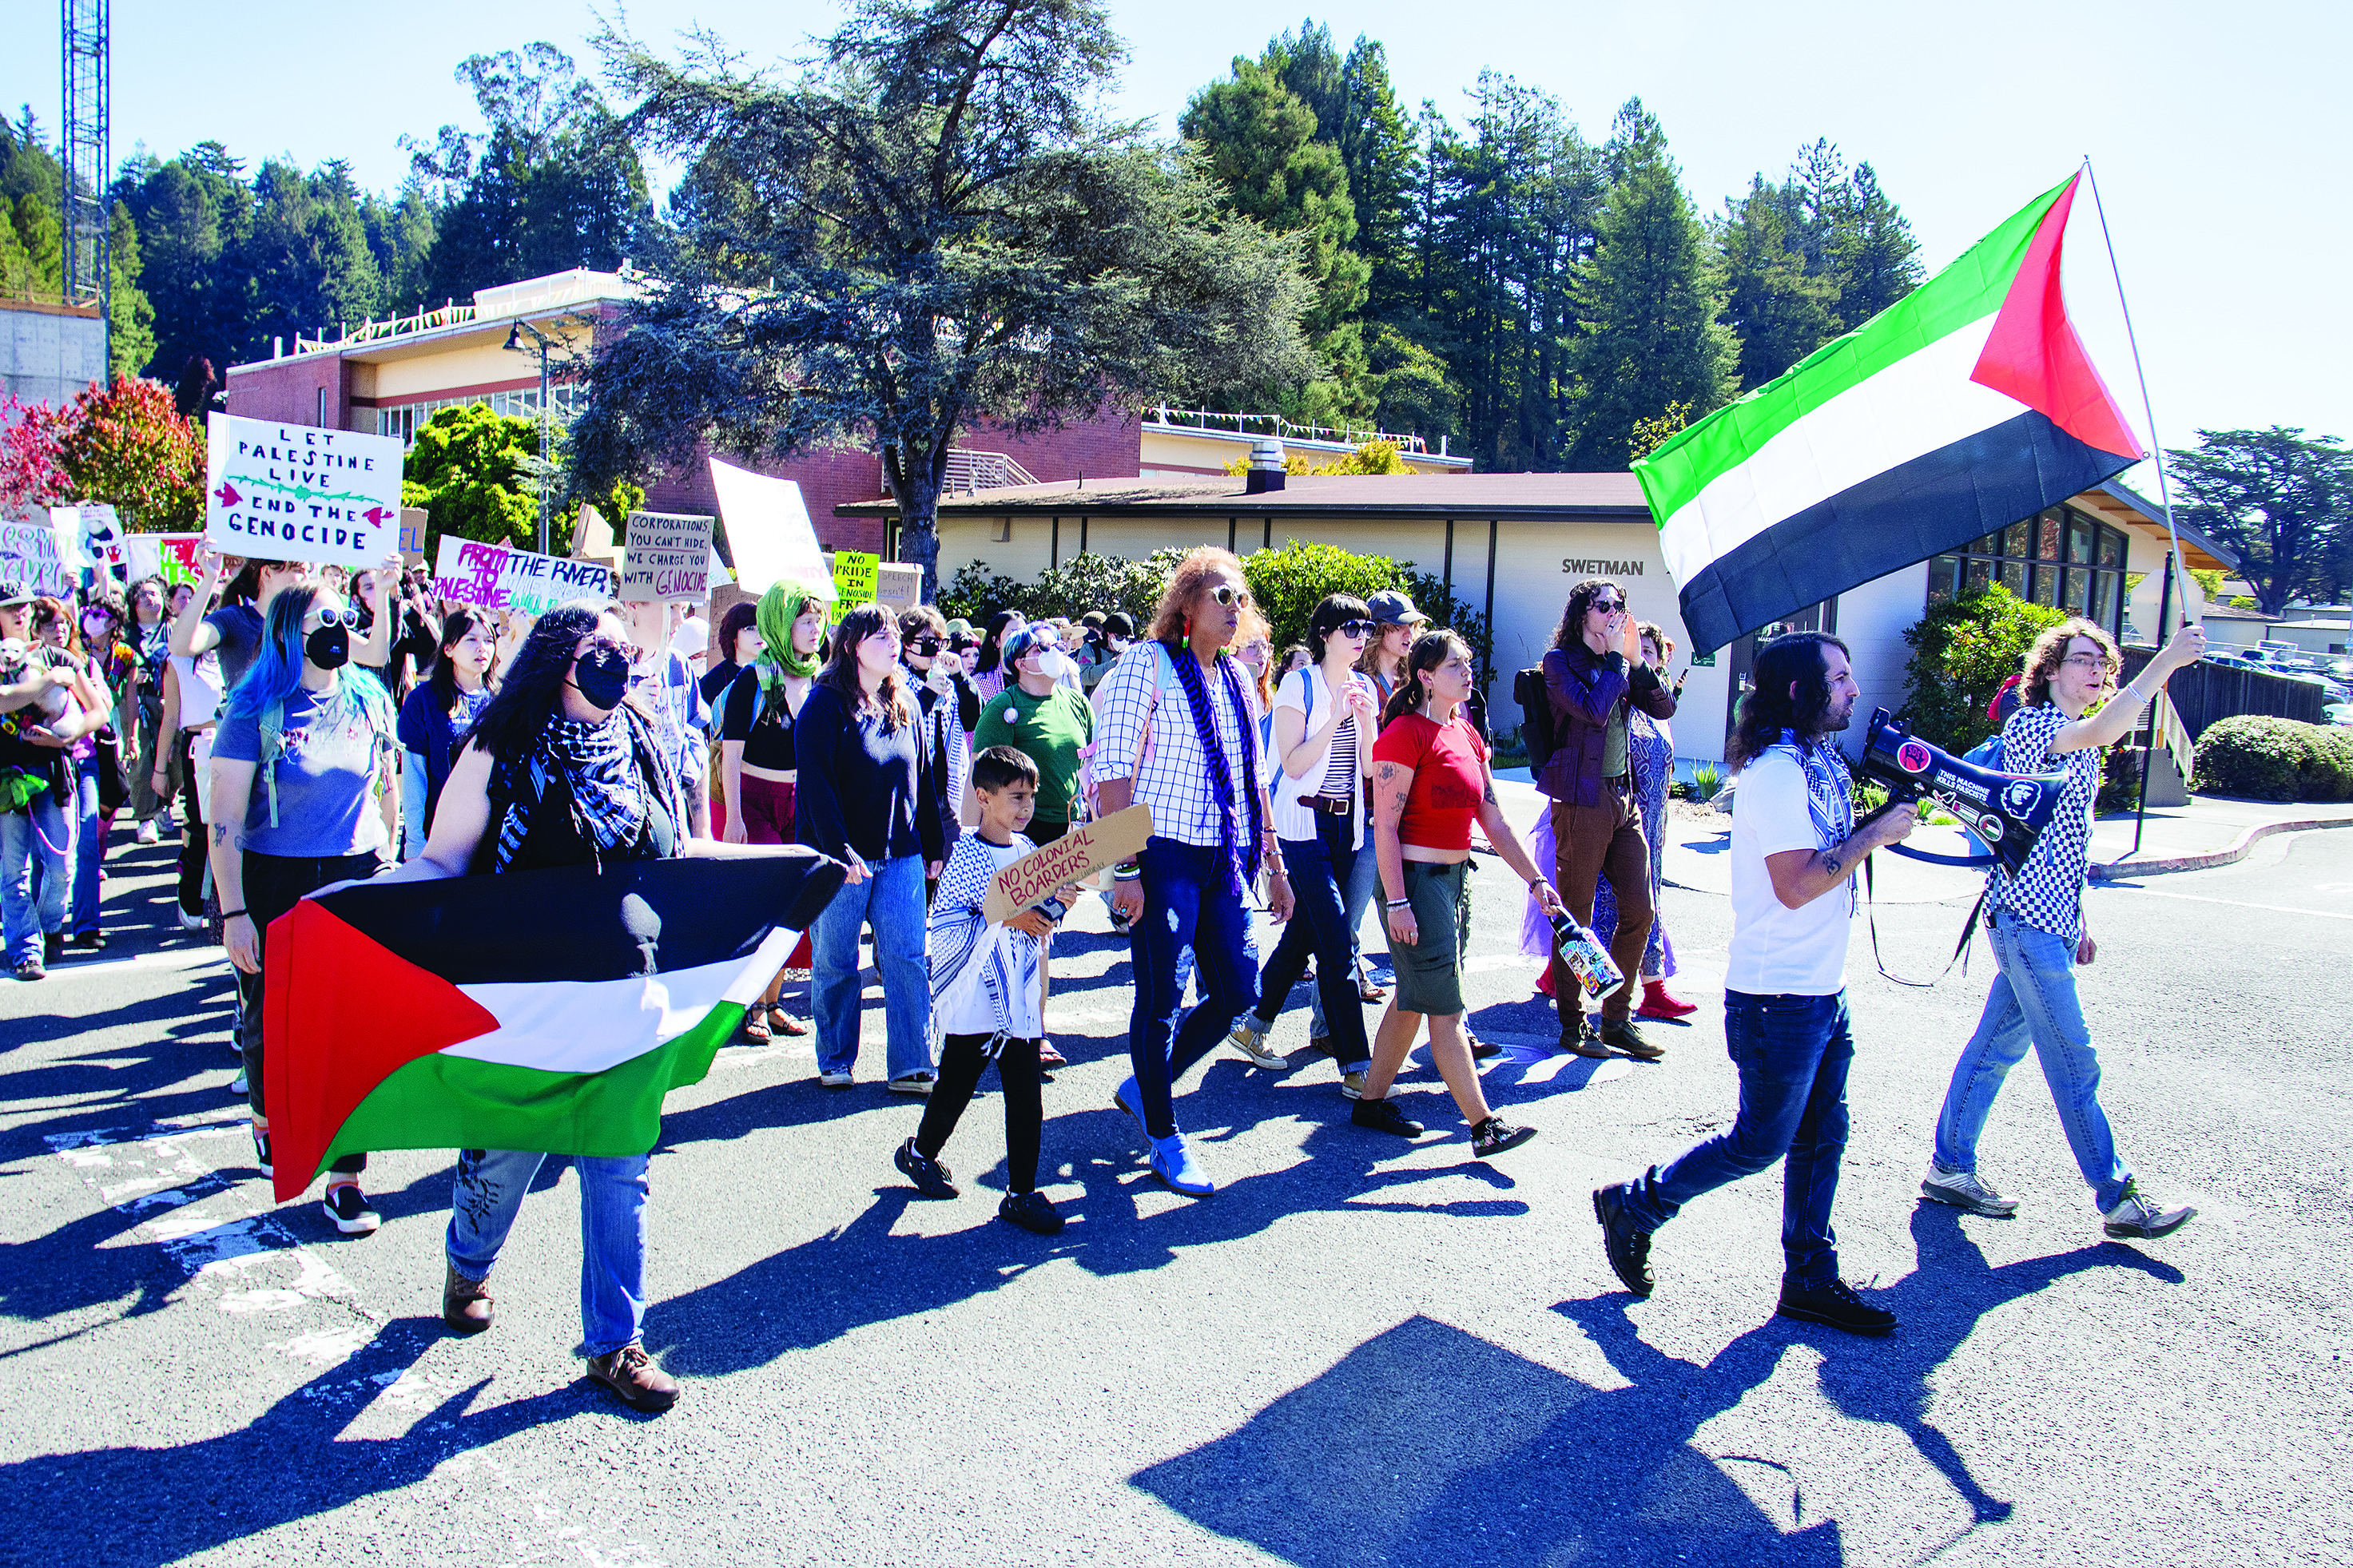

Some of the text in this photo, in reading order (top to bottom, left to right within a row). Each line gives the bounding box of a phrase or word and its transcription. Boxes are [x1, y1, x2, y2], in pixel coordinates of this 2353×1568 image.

[280, 429, 334, 445] LET
[239, 441, 374, 470] PALESTINE
[269, 468, 329, 487] LIVE
[252, 497, 356, 522] END THE
[229, 513, 367, 550] GENOCIDE
[632, 516, 710, 534] CORPORATIONS,
[630, 532, 707, 550] YOU CAN'T HIDE.
[458, 543, 509, 574] FROM
[508, 554, 550, 576] THE
[627, 553, 705, 566] WE CHARGE YOU
[847, 555, 864, 564] NO
[1561, 558, 1644, 576] SWETMAN
[469, 568, 499, 588] TO
[624, 571, 654, 584] WITH
[656, 569, 708, 595] GENOCIDE
[836, 565, 872, 578] PRIDE
[433, 577, 511, 609] PALESTINE
[1908, 745, 1922, 760] SDS
[1937, 775, 1988, 801] KILLS FASCISTS
[1939, 768, 1991, 796] THIS MACHINE
[998, 867, 1020, 895] NO
[1023, 830, 1095, 878] COLONIAL
[1009, 850, 1090, 907] BOARDERS
